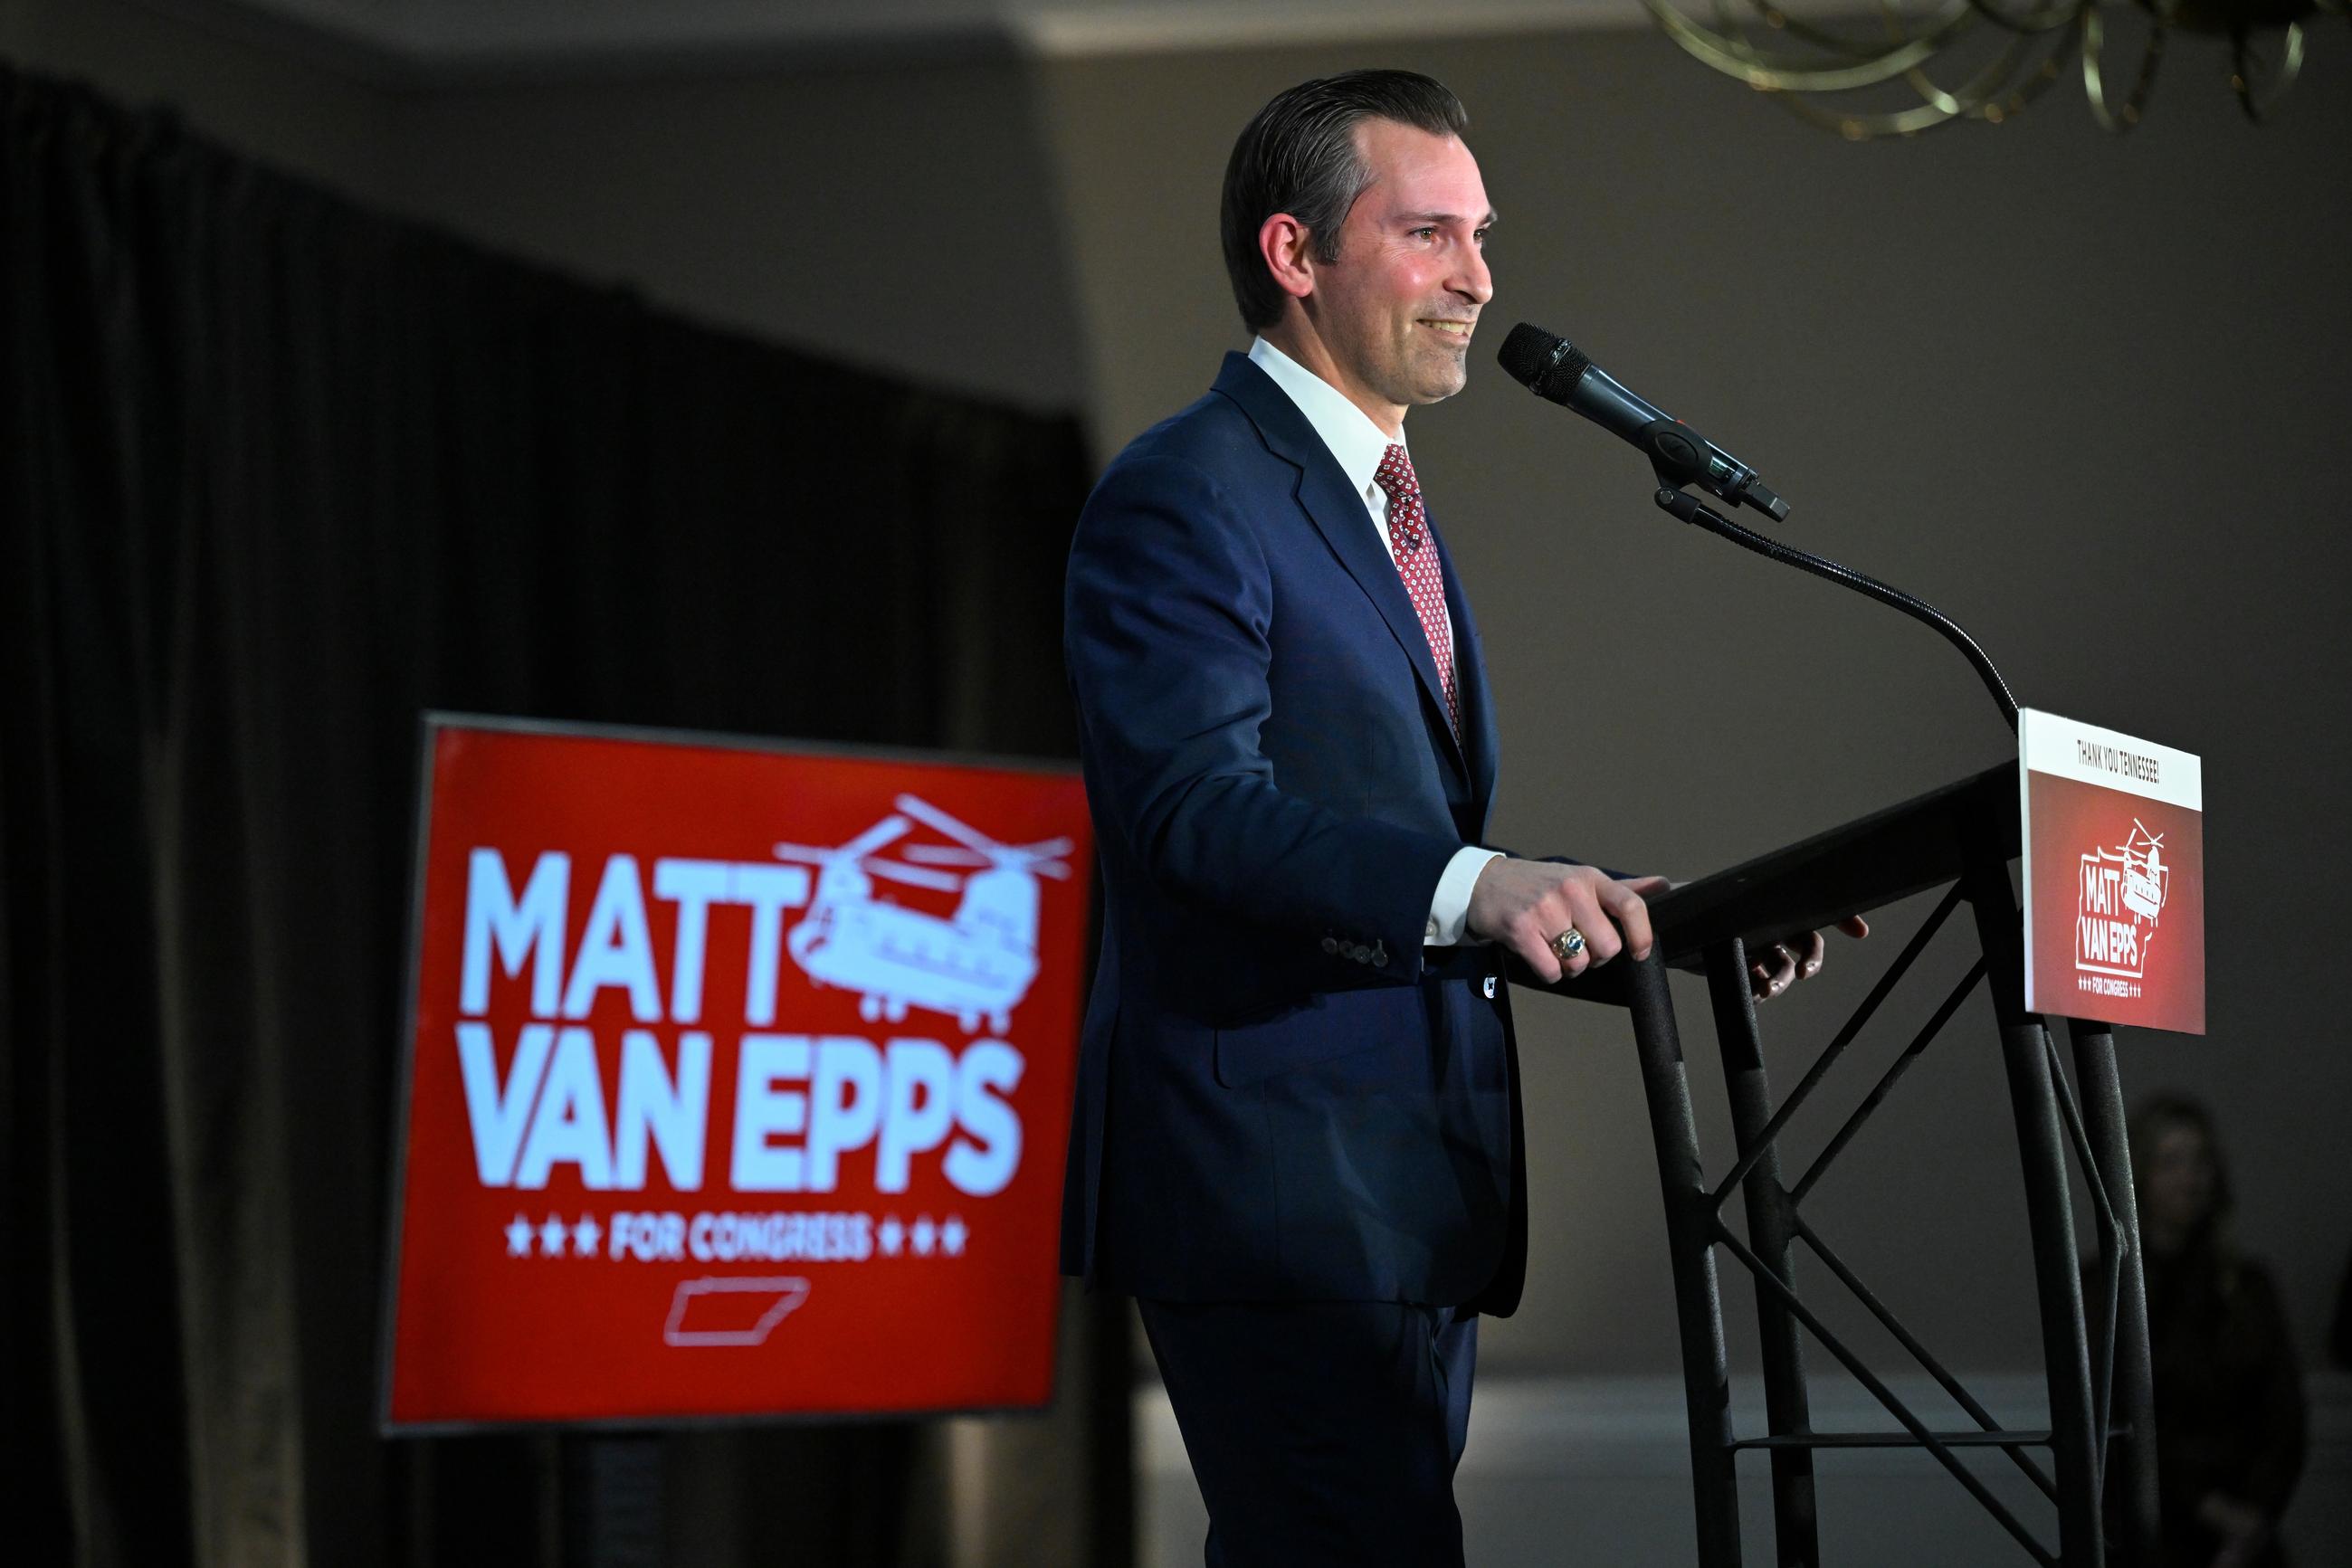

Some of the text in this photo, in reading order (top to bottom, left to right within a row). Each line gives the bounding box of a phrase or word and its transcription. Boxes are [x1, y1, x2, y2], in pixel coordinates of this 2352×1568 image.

[2078, 740, 2159, 784] THANK YOU TENNESSEE!
[2086, 865, 2120, 917] MATT
[460, 848, 811, 1025] MATT
[2082, 917, 2137, 965] VAN EPPS
[2092, 977, 2128, 998] FOR CONGRESS
[456, 1022, 1024, 1196] VAN EPPS
[610, 1212, 873, 1261] FOR CONGRESS
